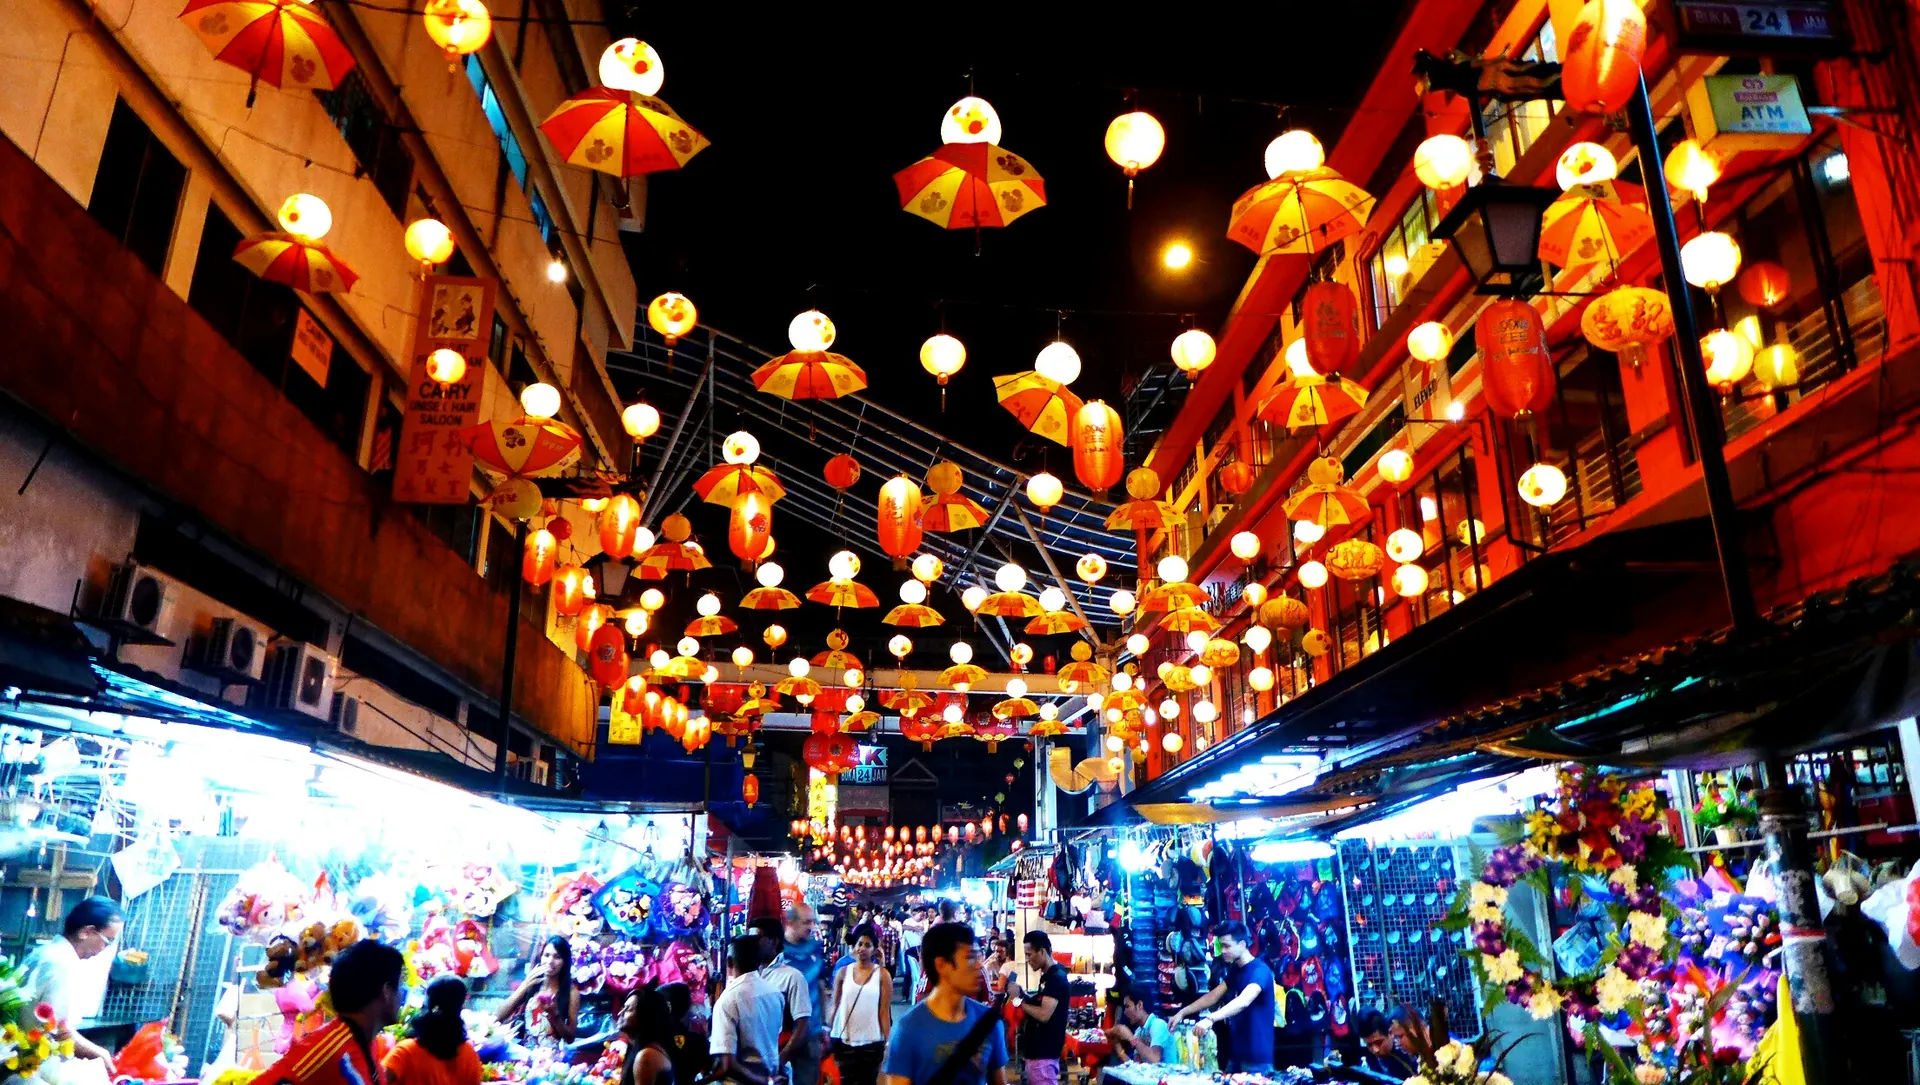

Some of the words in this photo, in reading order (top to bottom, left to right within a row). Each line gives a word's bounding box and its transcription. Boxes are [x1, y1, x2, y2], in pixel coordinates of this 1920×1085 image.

[1694, 9, 1732, 25] BUKA
[1746, 9, 1783, 31] 24
[1804, 15, 1828, 29] JAM
[1741, 104, 1785, 120] ATM
[452, 401, 477, 413] HAIR
[420, 413, 462, 426] SALOON
[858, 768, 870, 782] 24
[872, 768, 887, 782] JAM
